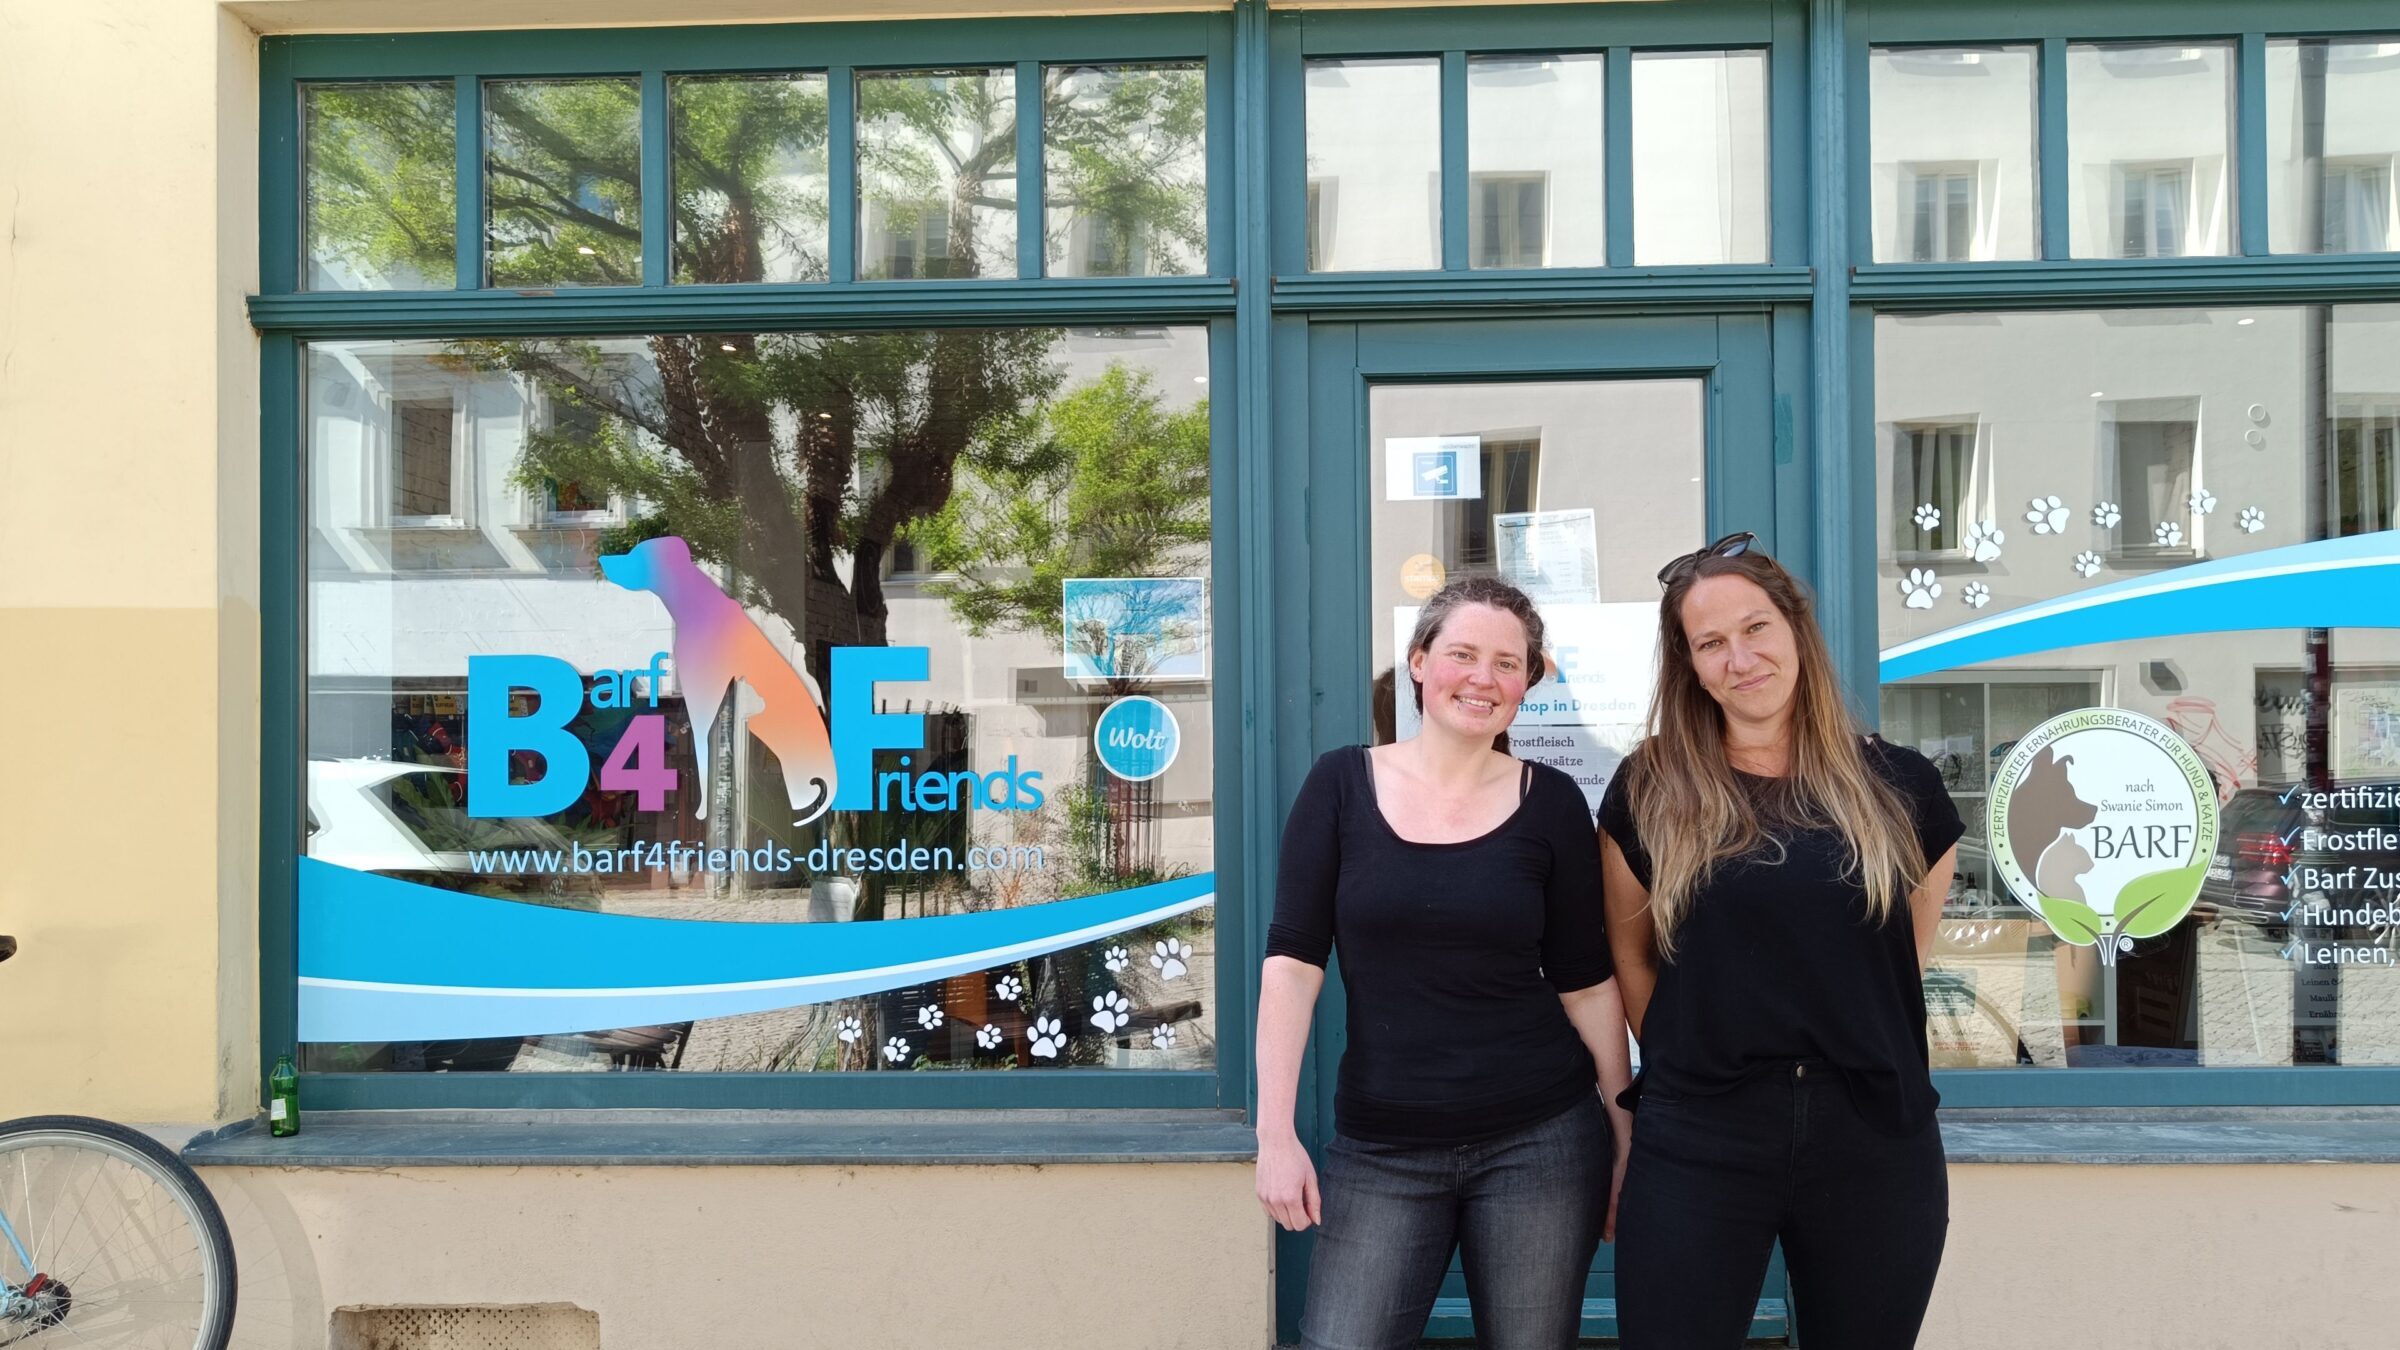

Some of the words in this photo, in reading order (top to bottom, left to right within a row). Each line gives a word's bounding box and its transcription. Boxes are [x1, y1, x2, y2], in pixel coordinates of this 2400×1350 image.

[1518, 699, 1549, 716] hop
[1553, 699, 1568, 711] in
[1572, 698, 1637, 712] Dresden
[600, 714, 678, 812] 4
[830, 646, 1044, 812] Friends
[1109, 727, 1167, 750] Wolt
[2025, 714, 2160, 753] ERNÄHRUNGSBERATER
[2158, 733, 2182, 756] FÜR
[2178, 753, 2205, 789] HUND
[1993, 750, 2030, 838] ZERTIFIZIERTER
[2125, 778, 2155, 792] nach
[2197, 790, 2209, 802] &
[2100, 798, 2142, 812] Swanie
[2145, 798, 2184, 812] Simon
[2200, 803, 2214, 842] KATZE
[2090, 824, 2193, 859] BARF
[468, 839, 1044, 874] www.barf4friends-dresden.com
[2304, 866, 2357, 890] Barf
[2303, 902, 2400, 926] Hundeb
[2304, 942, 2396, 968] Leinen,
